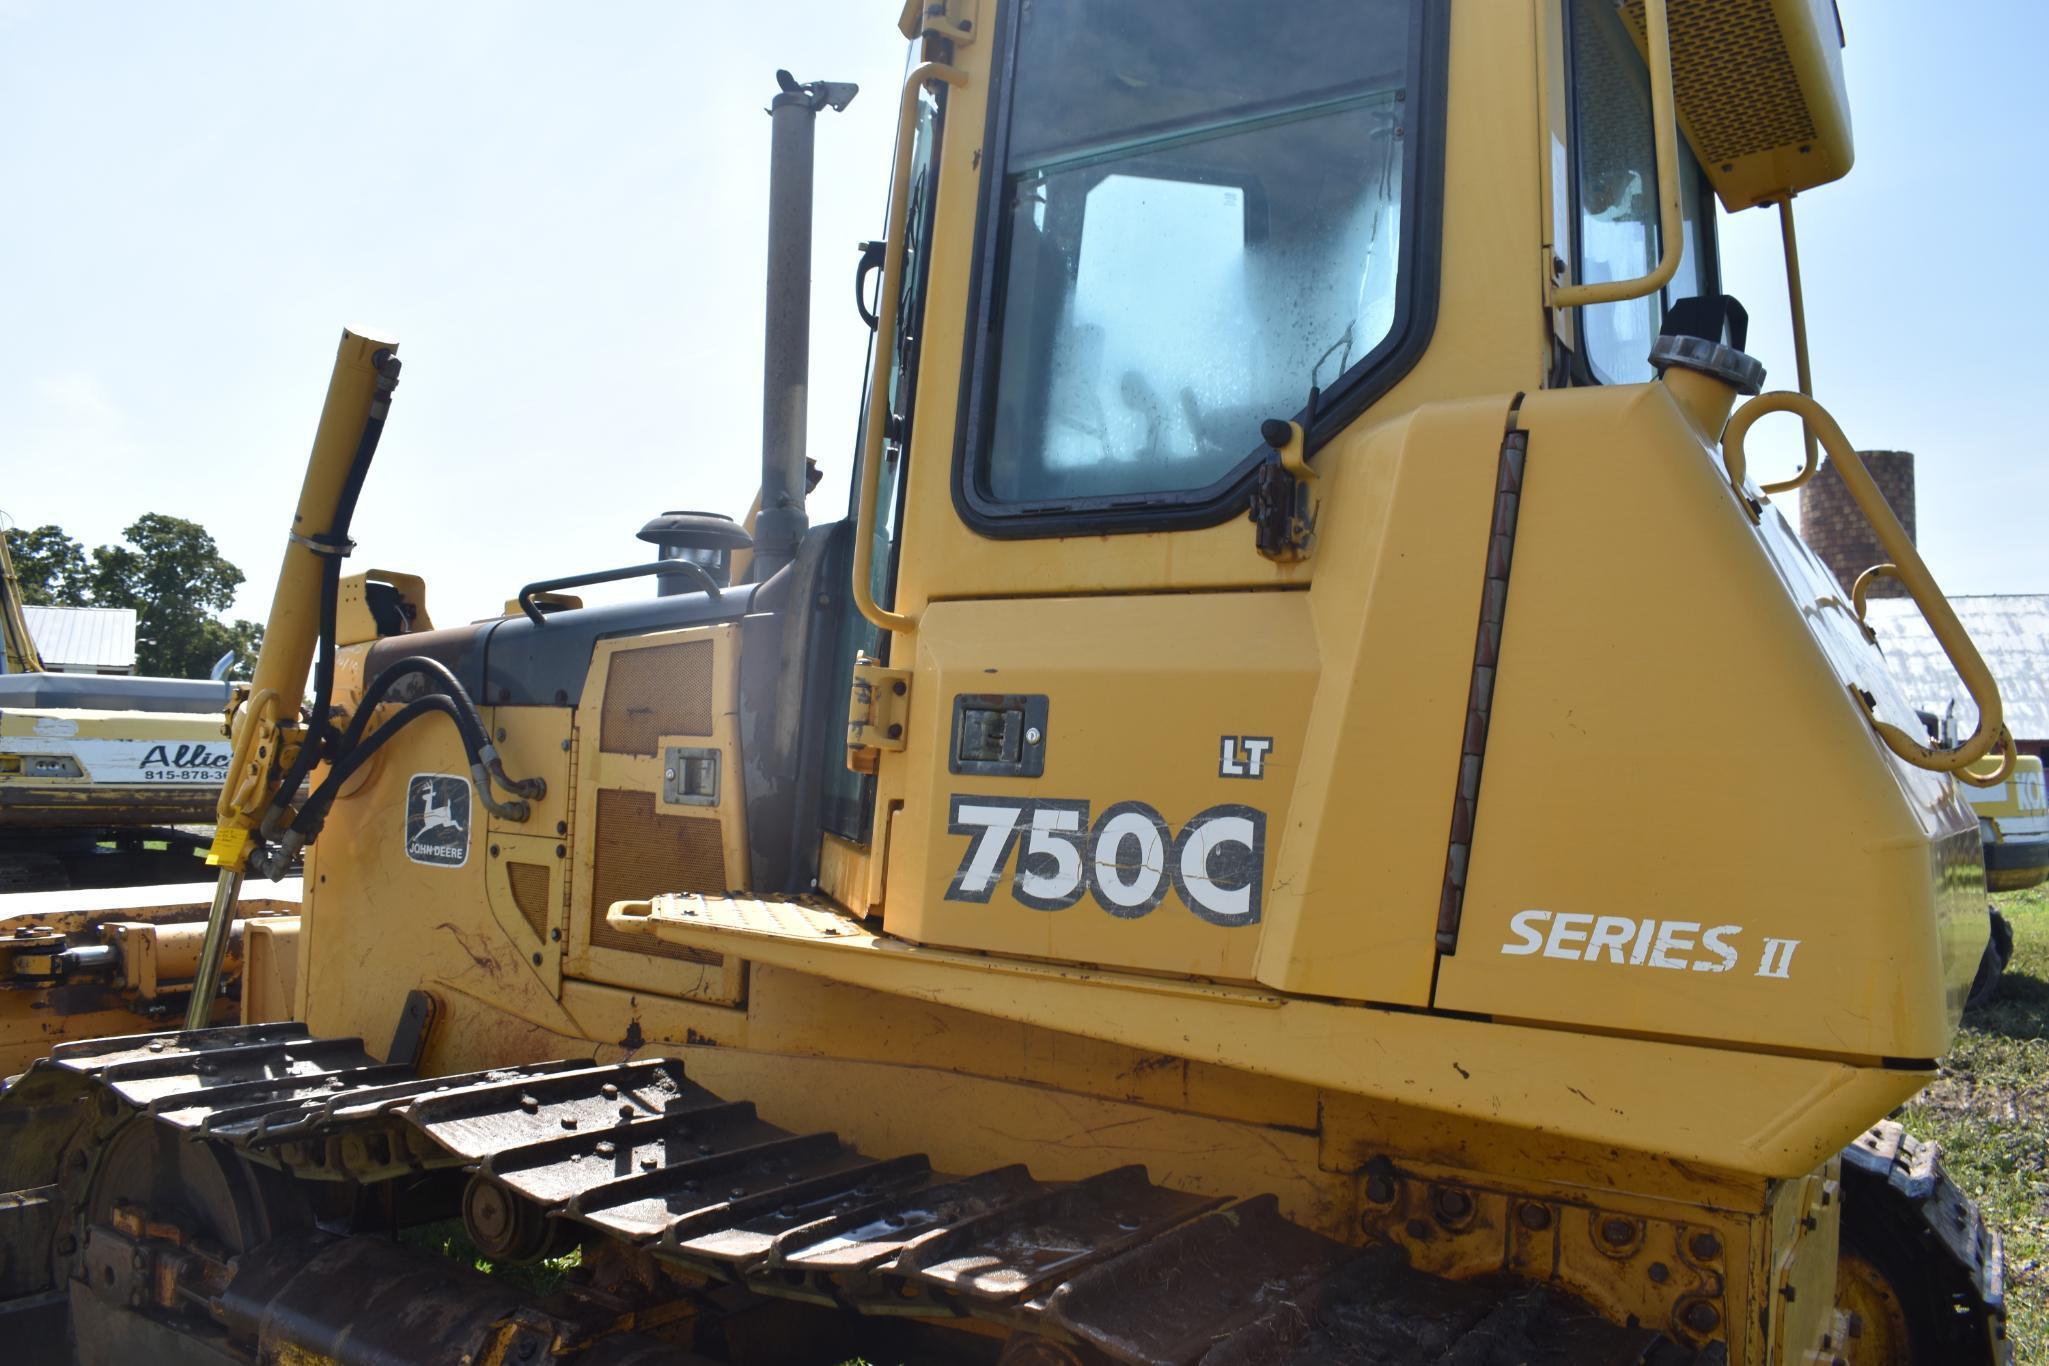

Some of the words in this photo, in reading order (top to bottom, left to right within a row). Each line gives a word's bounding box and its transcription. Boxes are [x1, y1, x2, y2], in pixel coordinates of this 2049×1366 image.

[1220, 737, 1272, 778] LT
[409, 843, 433, 855] JOHN
[433, 845, 463, 859] DEERE
[945, 795, 1266, 925] 750C
[1501, 909, 1743, 973] SERIES
[1754, 937, 1802, 979] II
